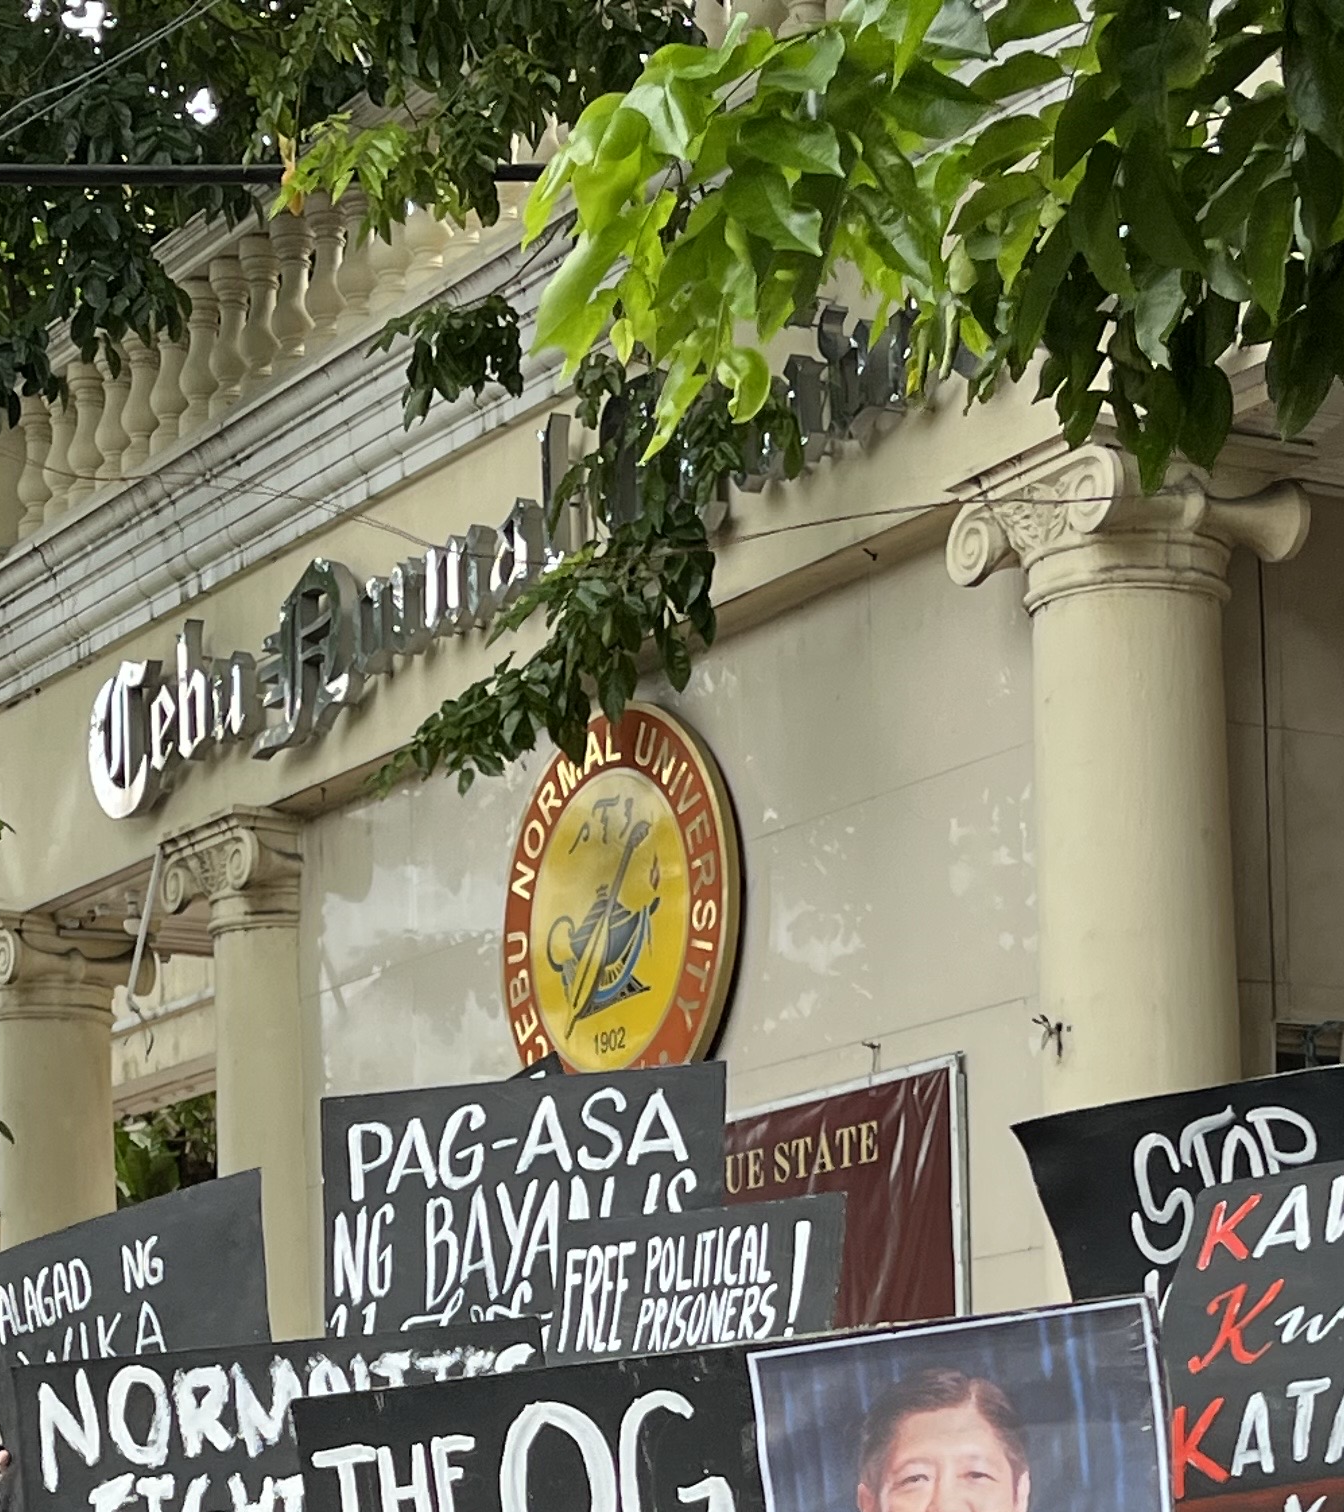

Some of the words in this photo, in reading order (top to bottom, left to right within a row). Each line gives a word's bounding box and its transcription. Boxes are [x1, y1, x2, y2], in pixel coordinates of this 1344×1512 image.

[87, 619, 248, 820] Cebu
[512, 722, 622, 900] NORMAL
[634, 720, 718, 1032] UNIVERSITY
[593, 1026, 627, 1056] 1902
[348, 1086, 689, 1203] PAG-ASA
[772, 1120, 881, 1185] STATE
[121, 1236, 164, 1295] NG
[332, 1205, 394, 1307] NG
[557, 1240, 637, 1353] FREE
[644, 1224, 773, 1300] POLITICAL
[632, 1282, 778, 1353] PRISONERS
